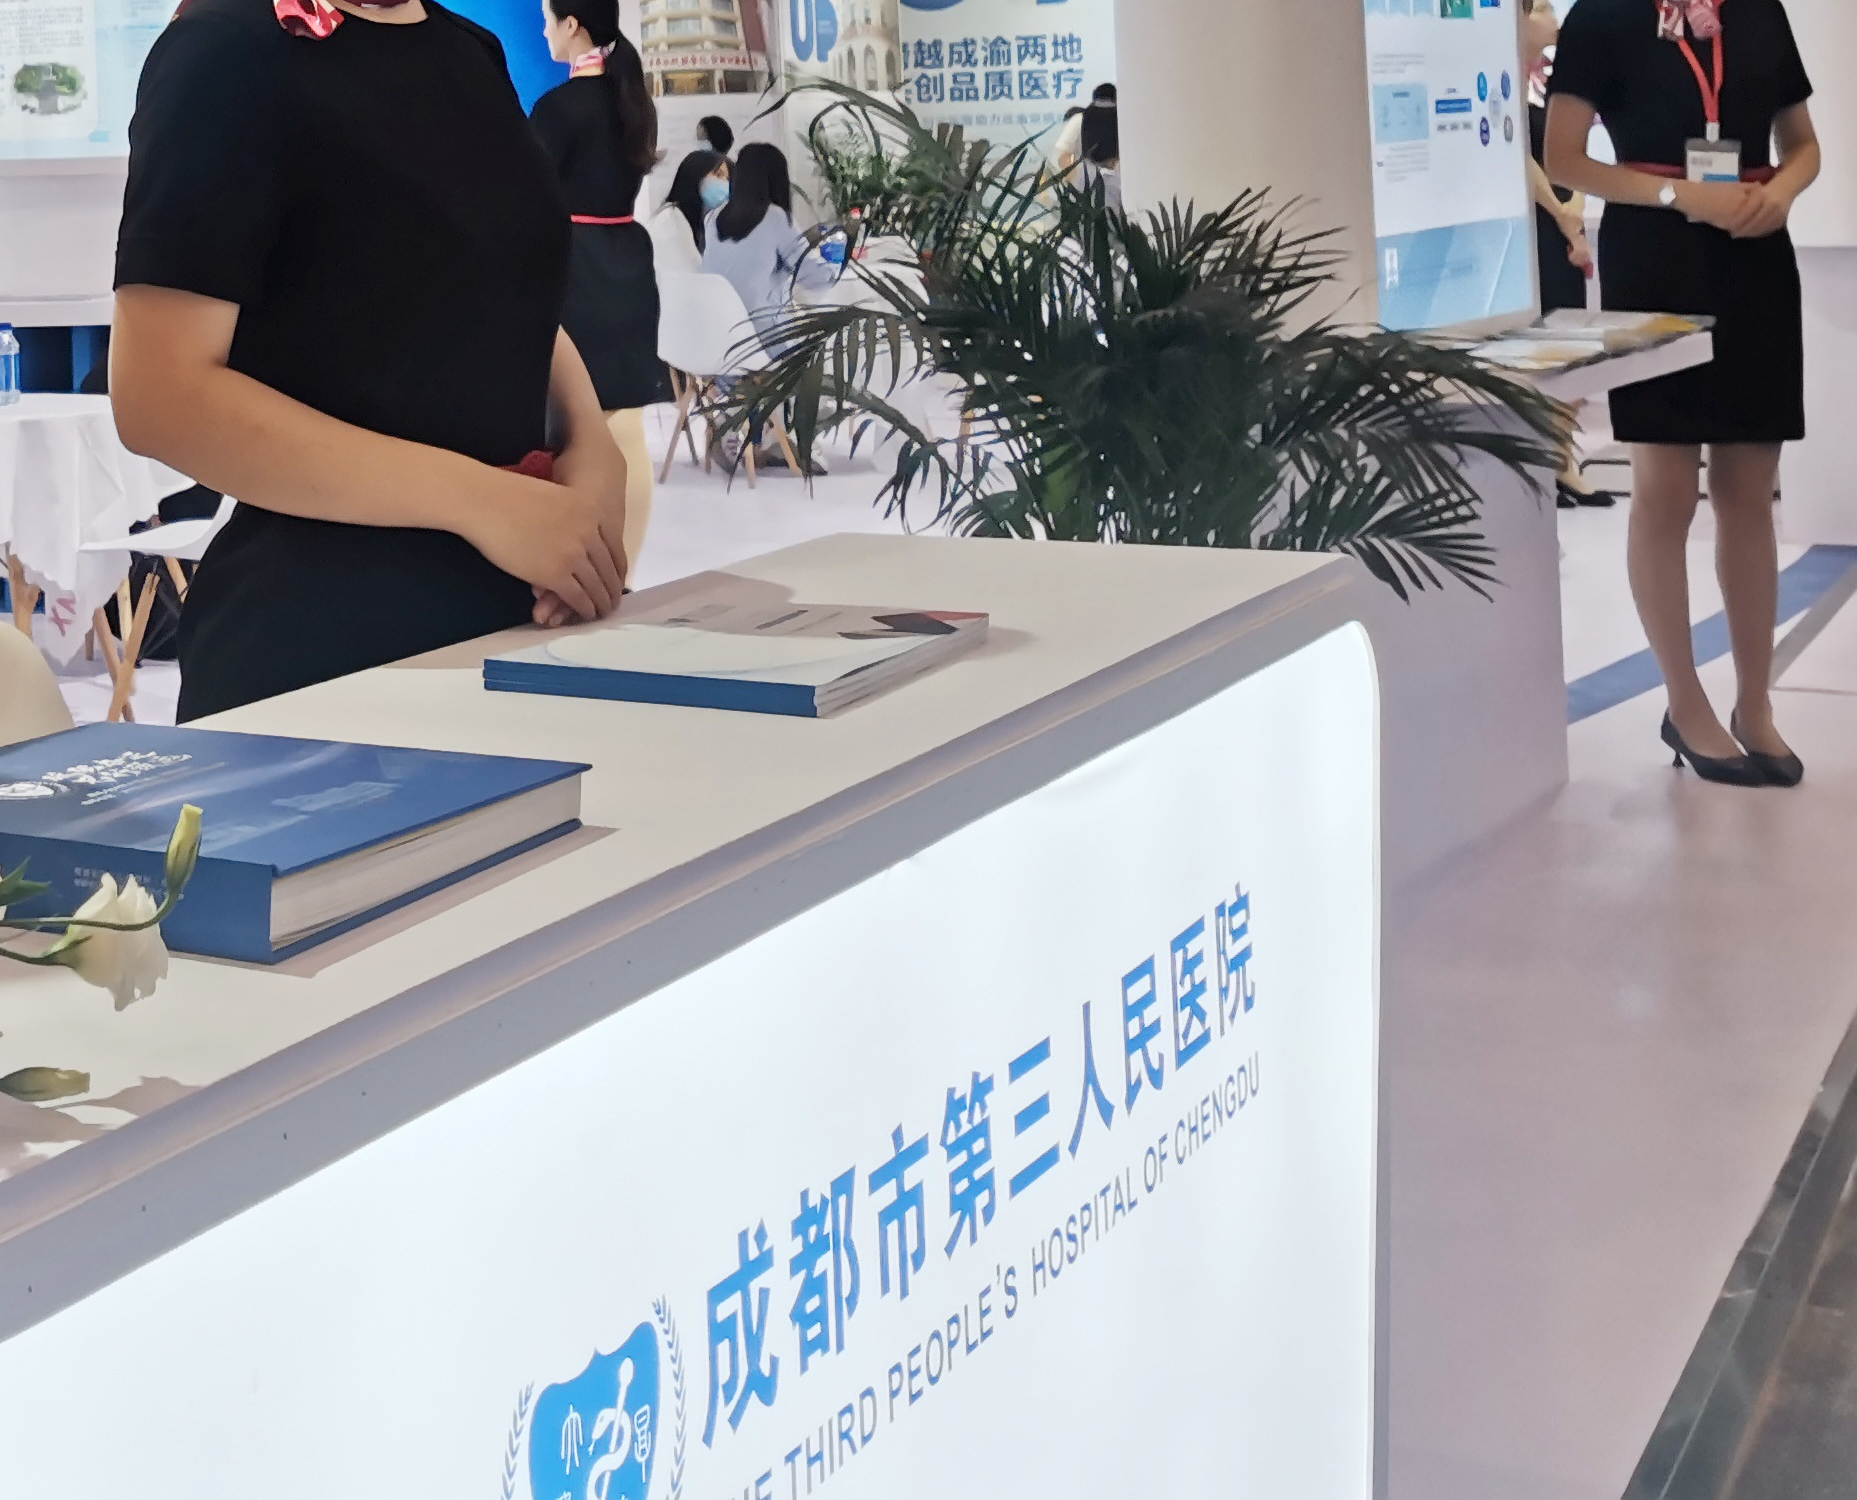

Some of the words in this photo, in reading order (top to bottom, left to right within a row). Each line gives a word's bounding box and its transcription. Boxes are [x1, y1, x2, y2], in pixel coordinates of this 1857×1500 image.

[902, 32, 1084, 70] 越成渝两地
[904, 67, 1085, 105] 创品质医疗
[701, 882, 1257, 1451] 成都市第三人民医院
[783, 1385, 878, 1500] THIRD
[888, 1264, 1019, 1423] PEOPLE'S
[1031, 1184, 1137, 1297] HOSPITAL
[1143, 1134, 1169, 1193] OF
[1175, 1051, 1261, 1165] CHENGDU
